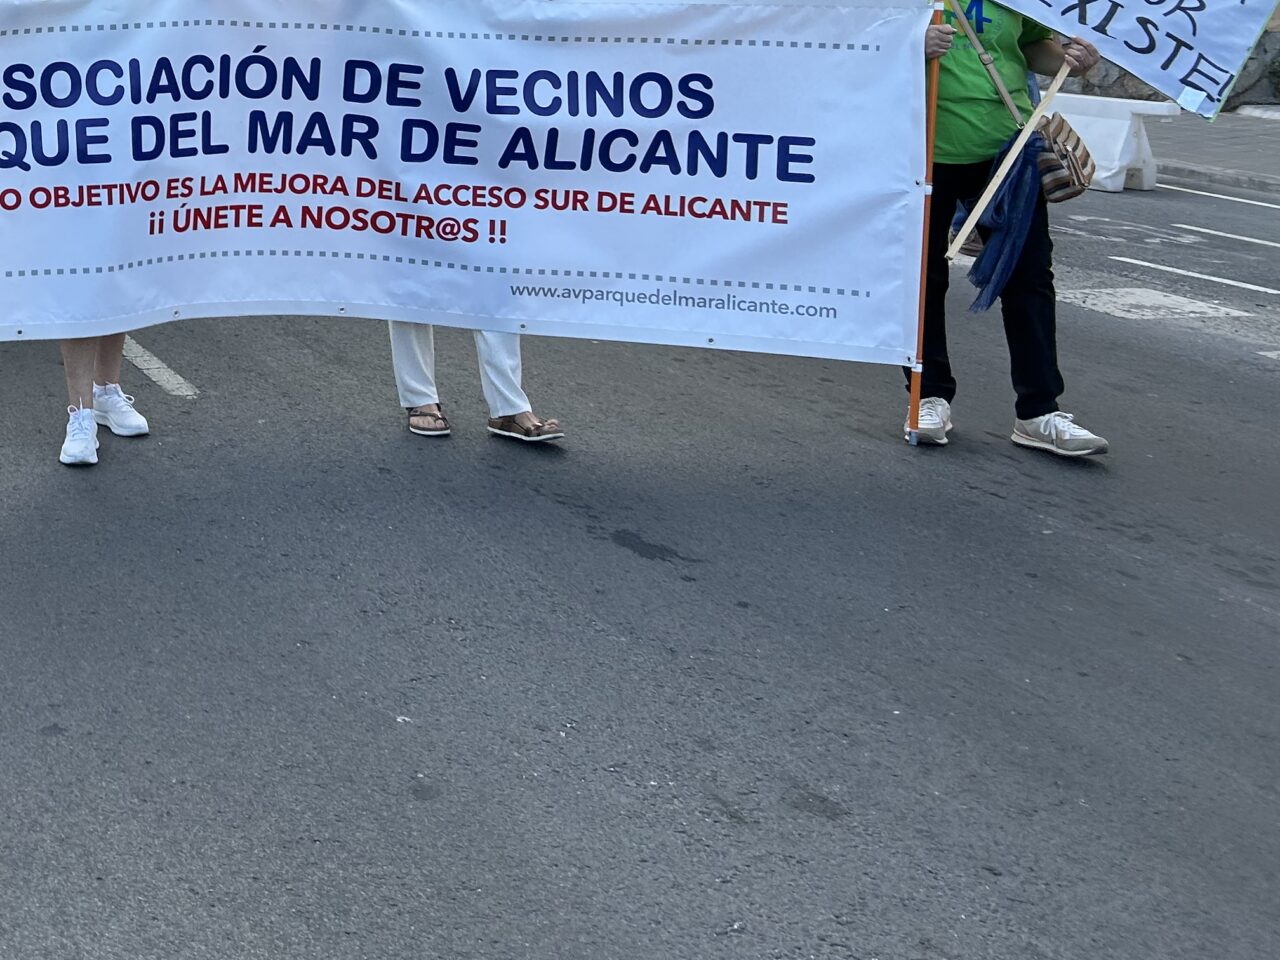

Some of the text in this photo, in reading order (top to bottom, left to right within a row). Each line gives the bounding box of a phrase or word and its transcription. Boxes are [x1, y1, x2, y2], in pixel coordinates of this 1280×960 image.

[342, 59, 425, 107] DE
[444, 66, 716, 120] VECINOS
[131, 110, 230, 162] DEL
[247, 109, 380, 160] MAR
[400, 118, 482, 166] DE
[497, 126, 817, 184] ALICANTE
[29, 179, 161, 209] OBJETIVO
[166, 176, 194, 200] ES
[199, 174, 229, 197] LA
[233, 172, 350, 197] MEJORA
[356, 176, 408, 203] DEL
[412, 183, 527, 209] ACCESO
[533, 188, 590, 212] SUR
[596, 191, 635, 215] DE
[640, 193, 789, 225] ALICANTE
[148, 203, 508, 245] ¡¡ ÚNETE A NOSOTR@S !!
[510, 282, 838, 320] www.avparquedelmaralicante.com
